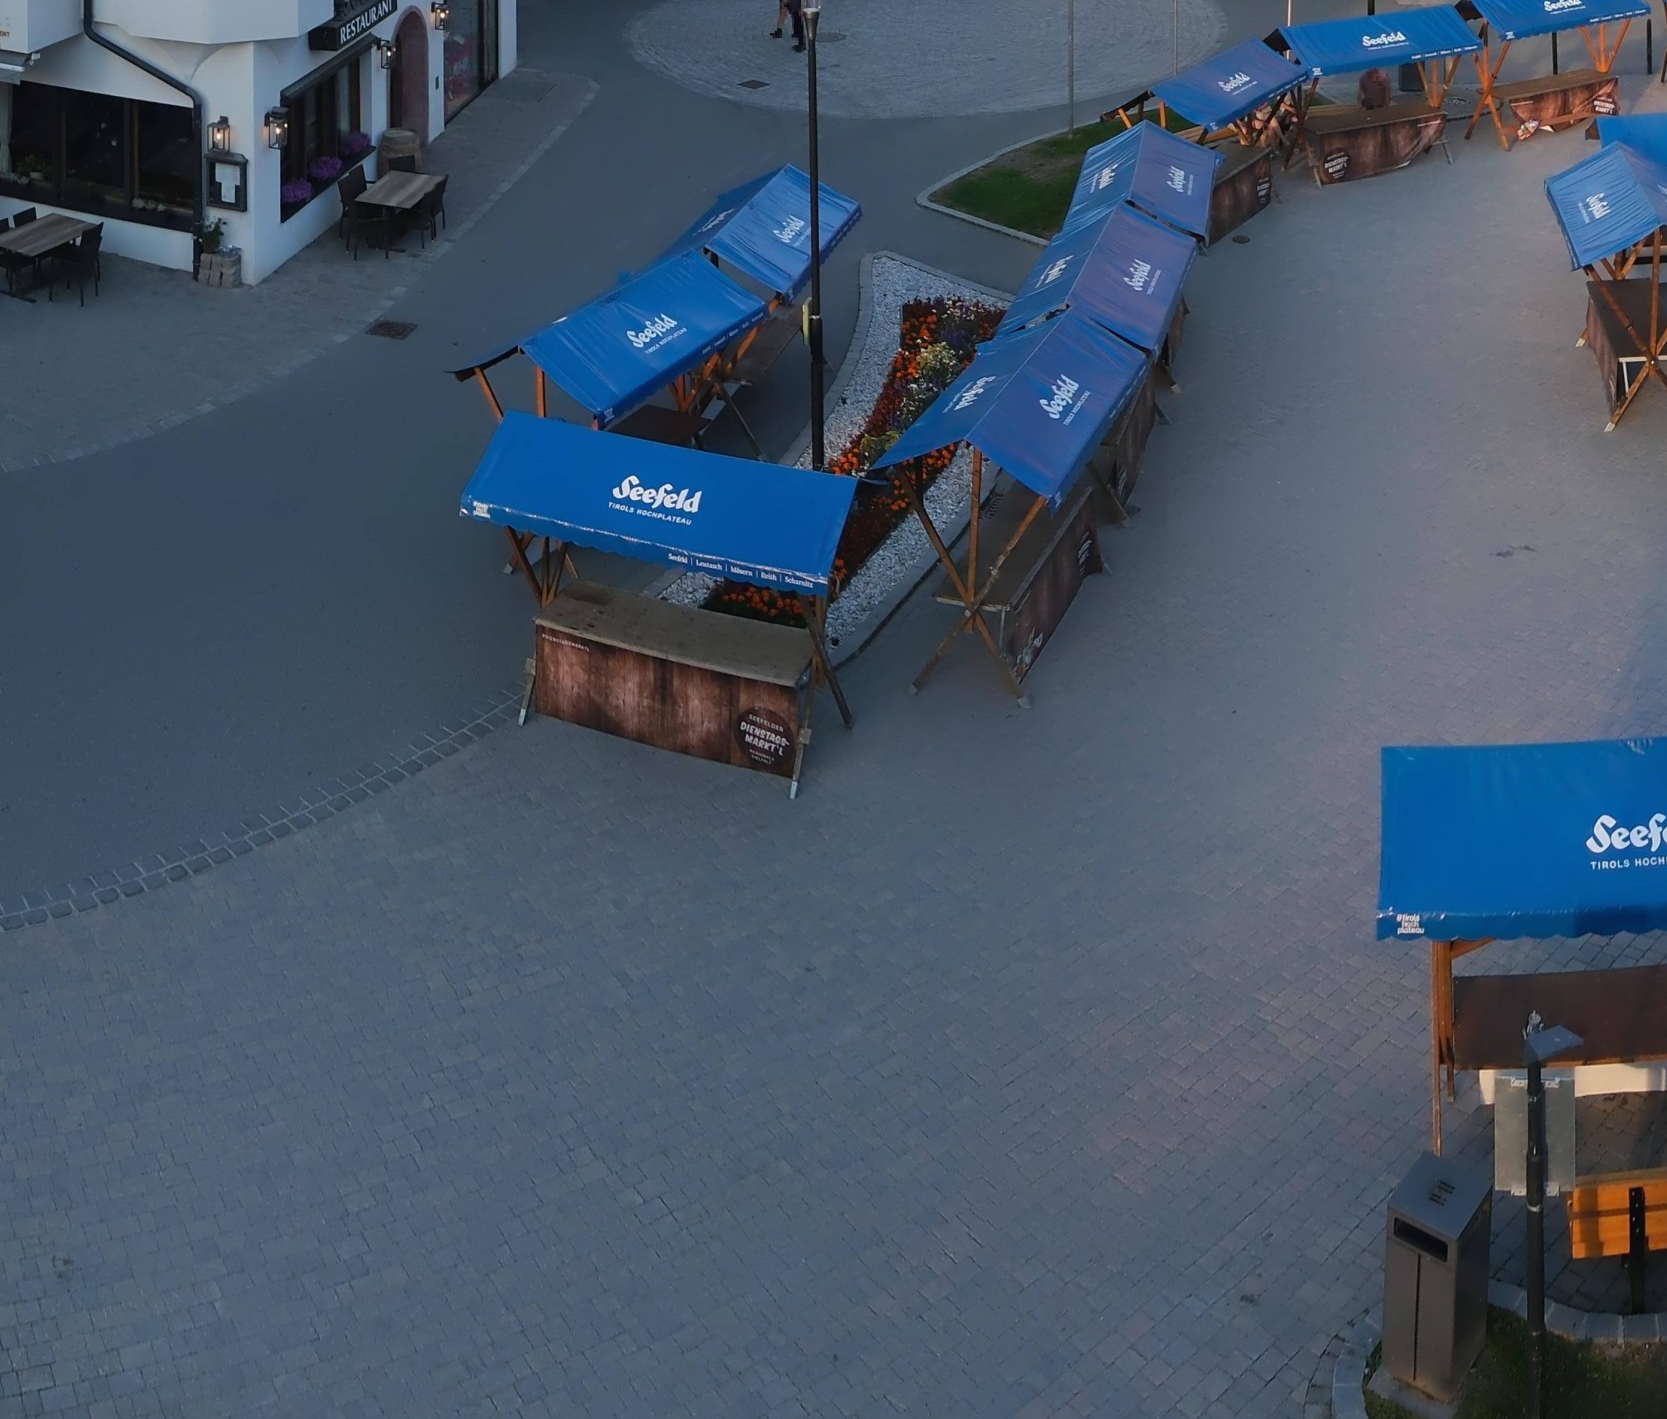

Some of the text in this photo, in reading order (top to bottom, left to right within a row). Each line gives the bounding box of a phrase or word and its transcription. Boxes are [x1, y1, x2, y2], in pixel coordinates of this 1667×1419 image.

[1362, 31, 1406, 47] Seefeld
[1217, 72, 1251, 93] Seefeld
[772, 214, 804, 243] Seefeld
[626, 312, 678, 349] Seefeld
[1039, 373, 1080, 420] Seefeld
[612, 474, 702, 515] Seefeld
[608, 502, 692, 526] TIROLS HOCHPLATEAU
[740, 722, 790, 747] DIENSTAGS-
[749, 714, 784, 733] SEEFELDER
[1590, 858, 1630, 871] TIROLS
